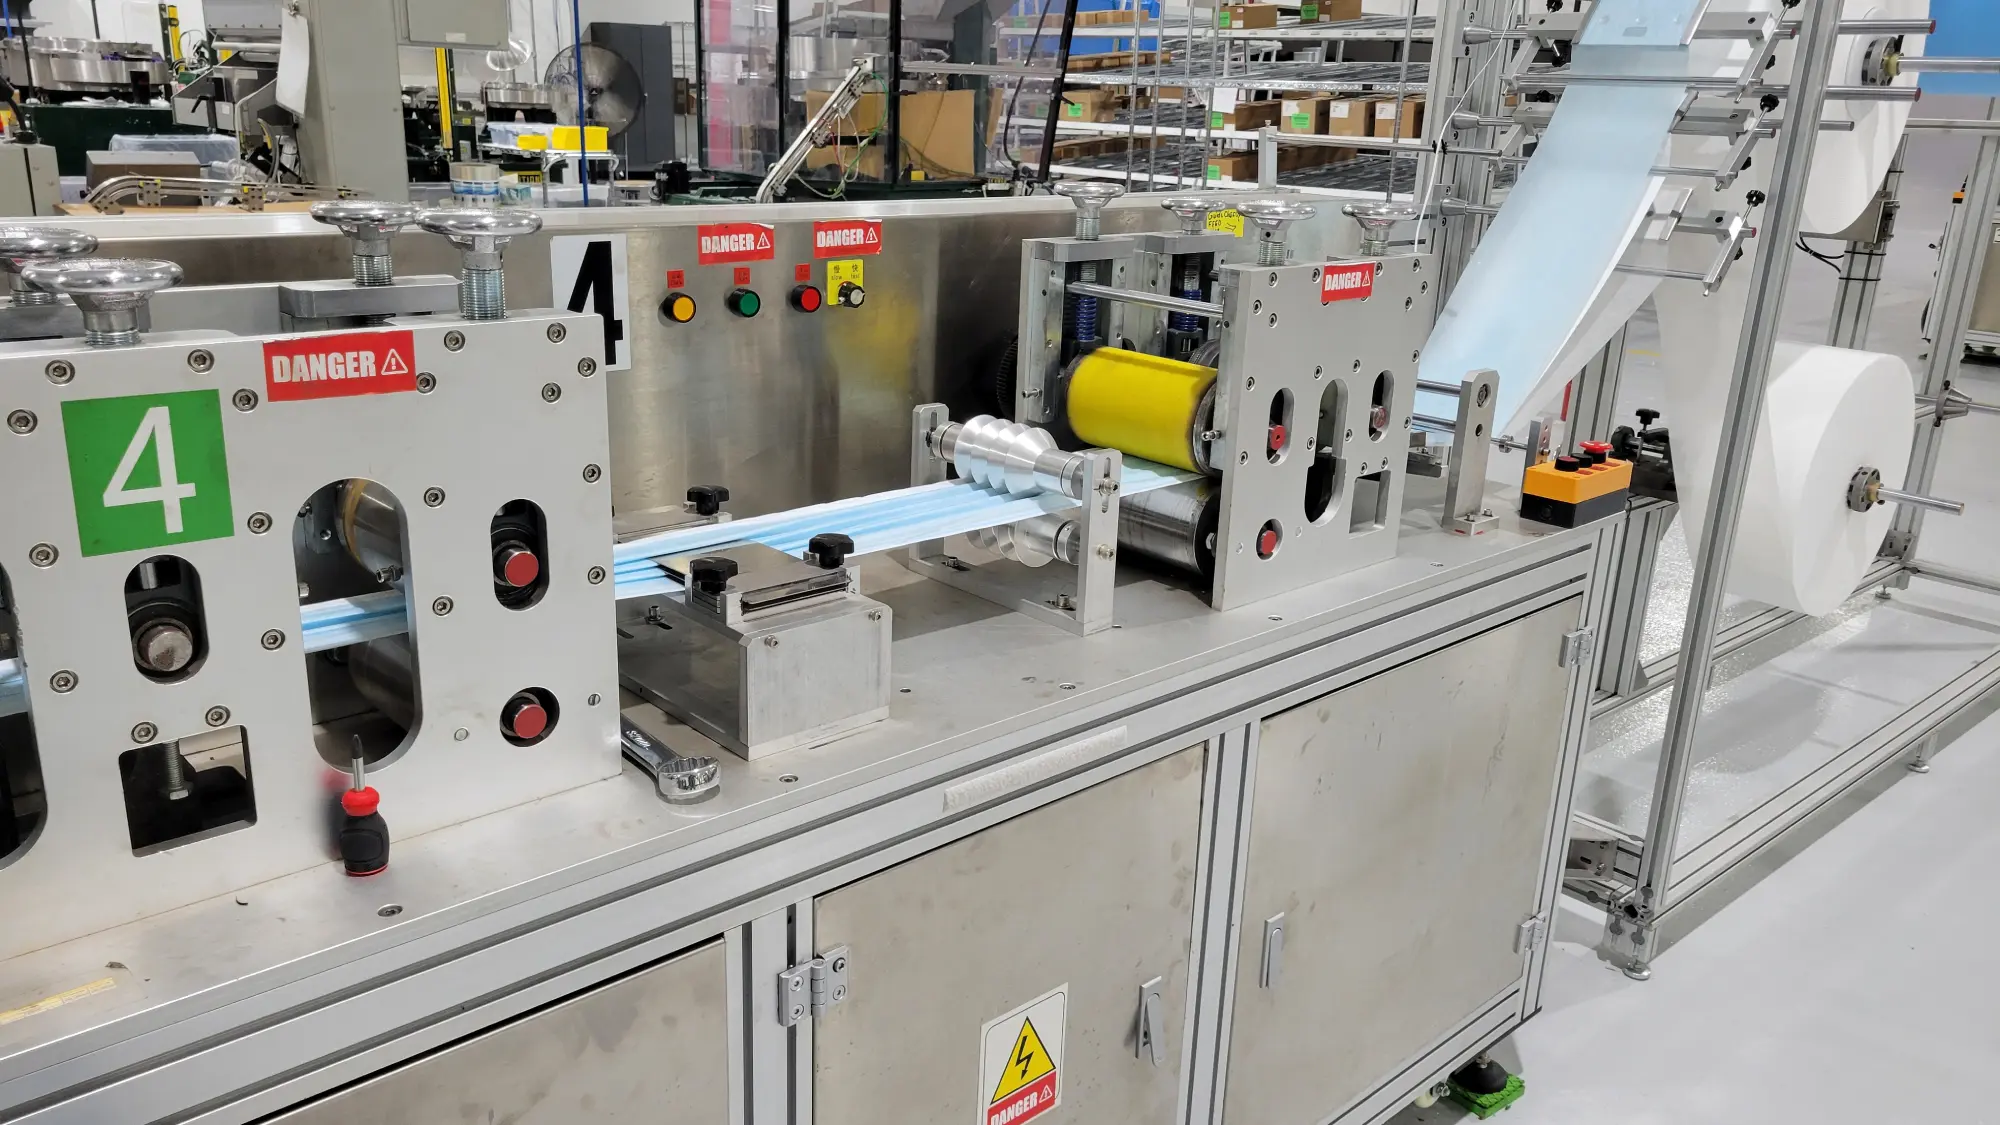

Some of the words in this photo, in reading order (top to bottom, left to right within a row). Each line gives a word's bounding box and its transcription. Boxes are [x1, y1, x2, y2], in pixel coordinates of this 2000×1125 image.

[701, 233, 755, 254] DANGER
[816, 227, 864, 248] DANGER
[1324, 271, 1362, 291] DANGER
[567, 241, 623, 365] 4
[272, 350, 377, 383] DANGER
[103, 406, 196, 534] 4
